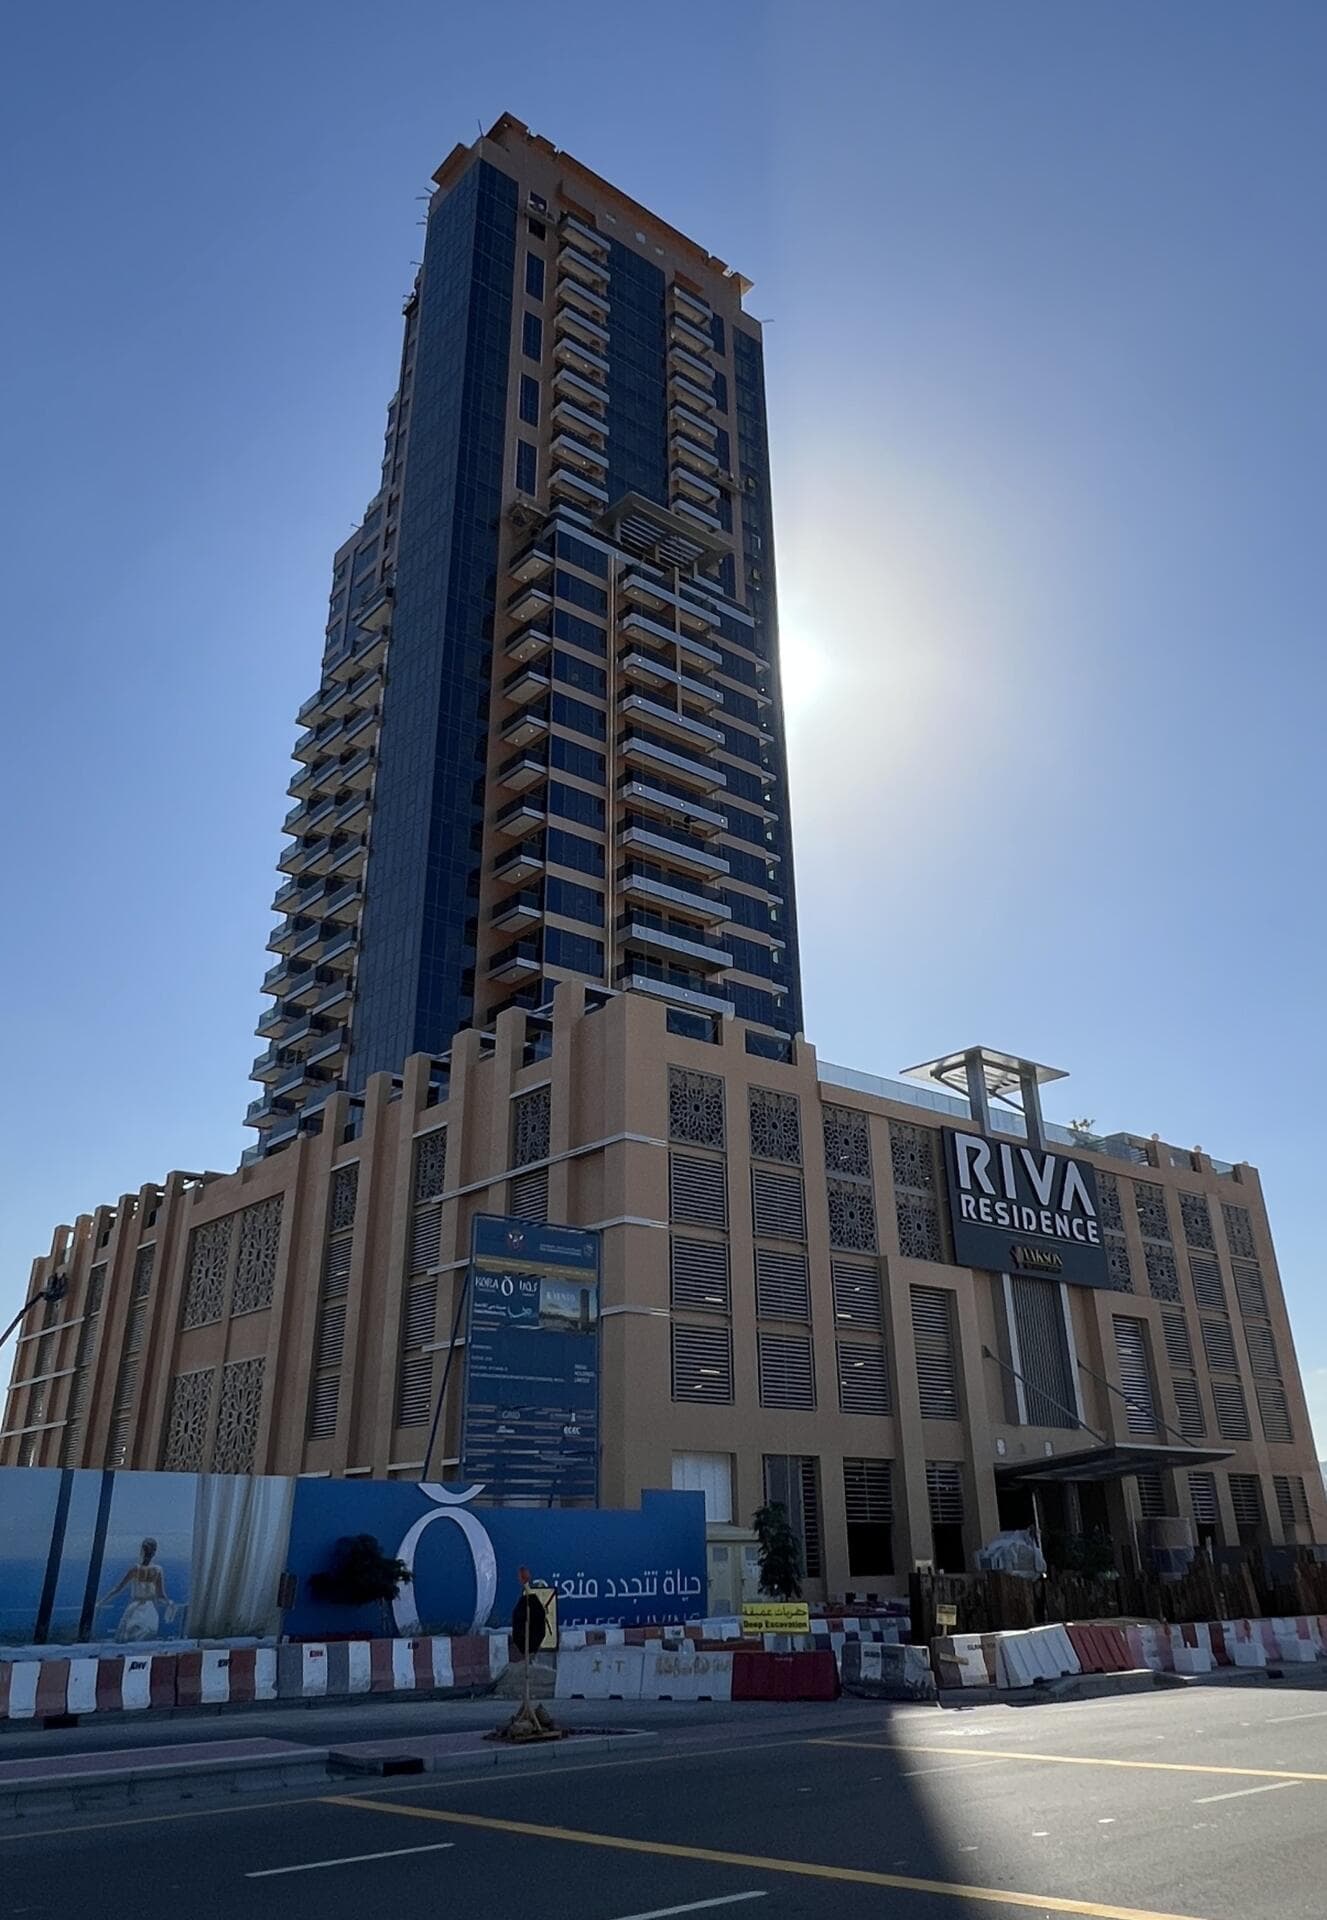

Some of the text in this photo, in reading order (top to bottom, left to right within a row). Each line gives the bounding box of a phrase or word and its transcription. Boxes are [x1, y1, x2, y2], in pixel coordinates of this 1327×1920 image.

[954, 1131, 1097, 1217] RIVA
[960, 1193, 1100, 1244] RESIDENCE
[604, 1570, 658, 1604] تتجدد
[662, 1568, 702, 1602] حياة
[743, 1620, 807, 1629] Deep Excavation
